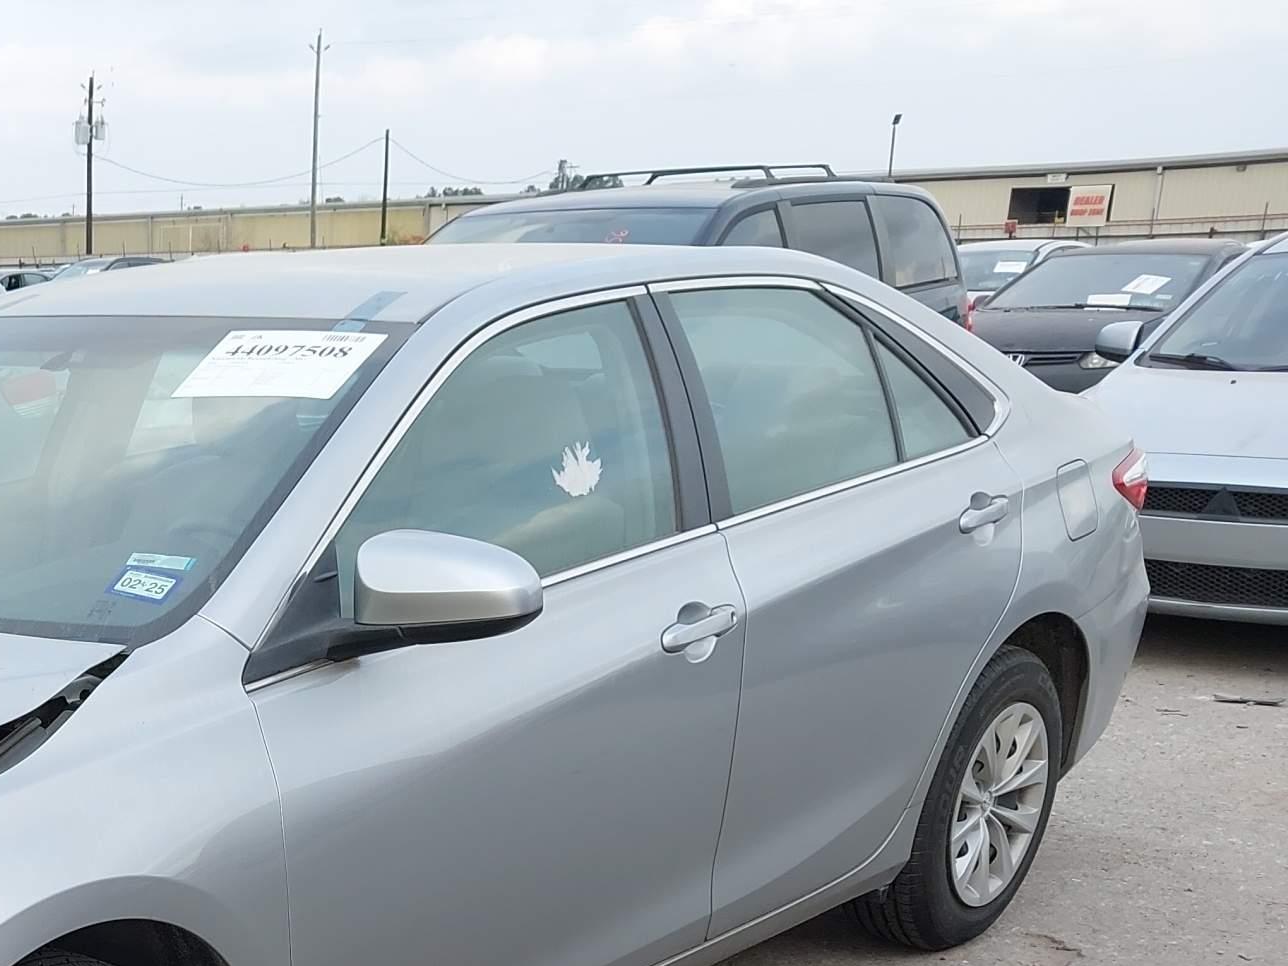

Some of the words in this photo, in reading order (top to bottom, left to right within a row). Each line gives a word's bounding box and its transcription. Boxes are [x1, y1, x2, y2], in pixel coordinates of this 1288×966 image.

[225, 344, 353, 358] 44097508
[121, 577, 141, 589] 02
[145, 583, 168, 594] 25
